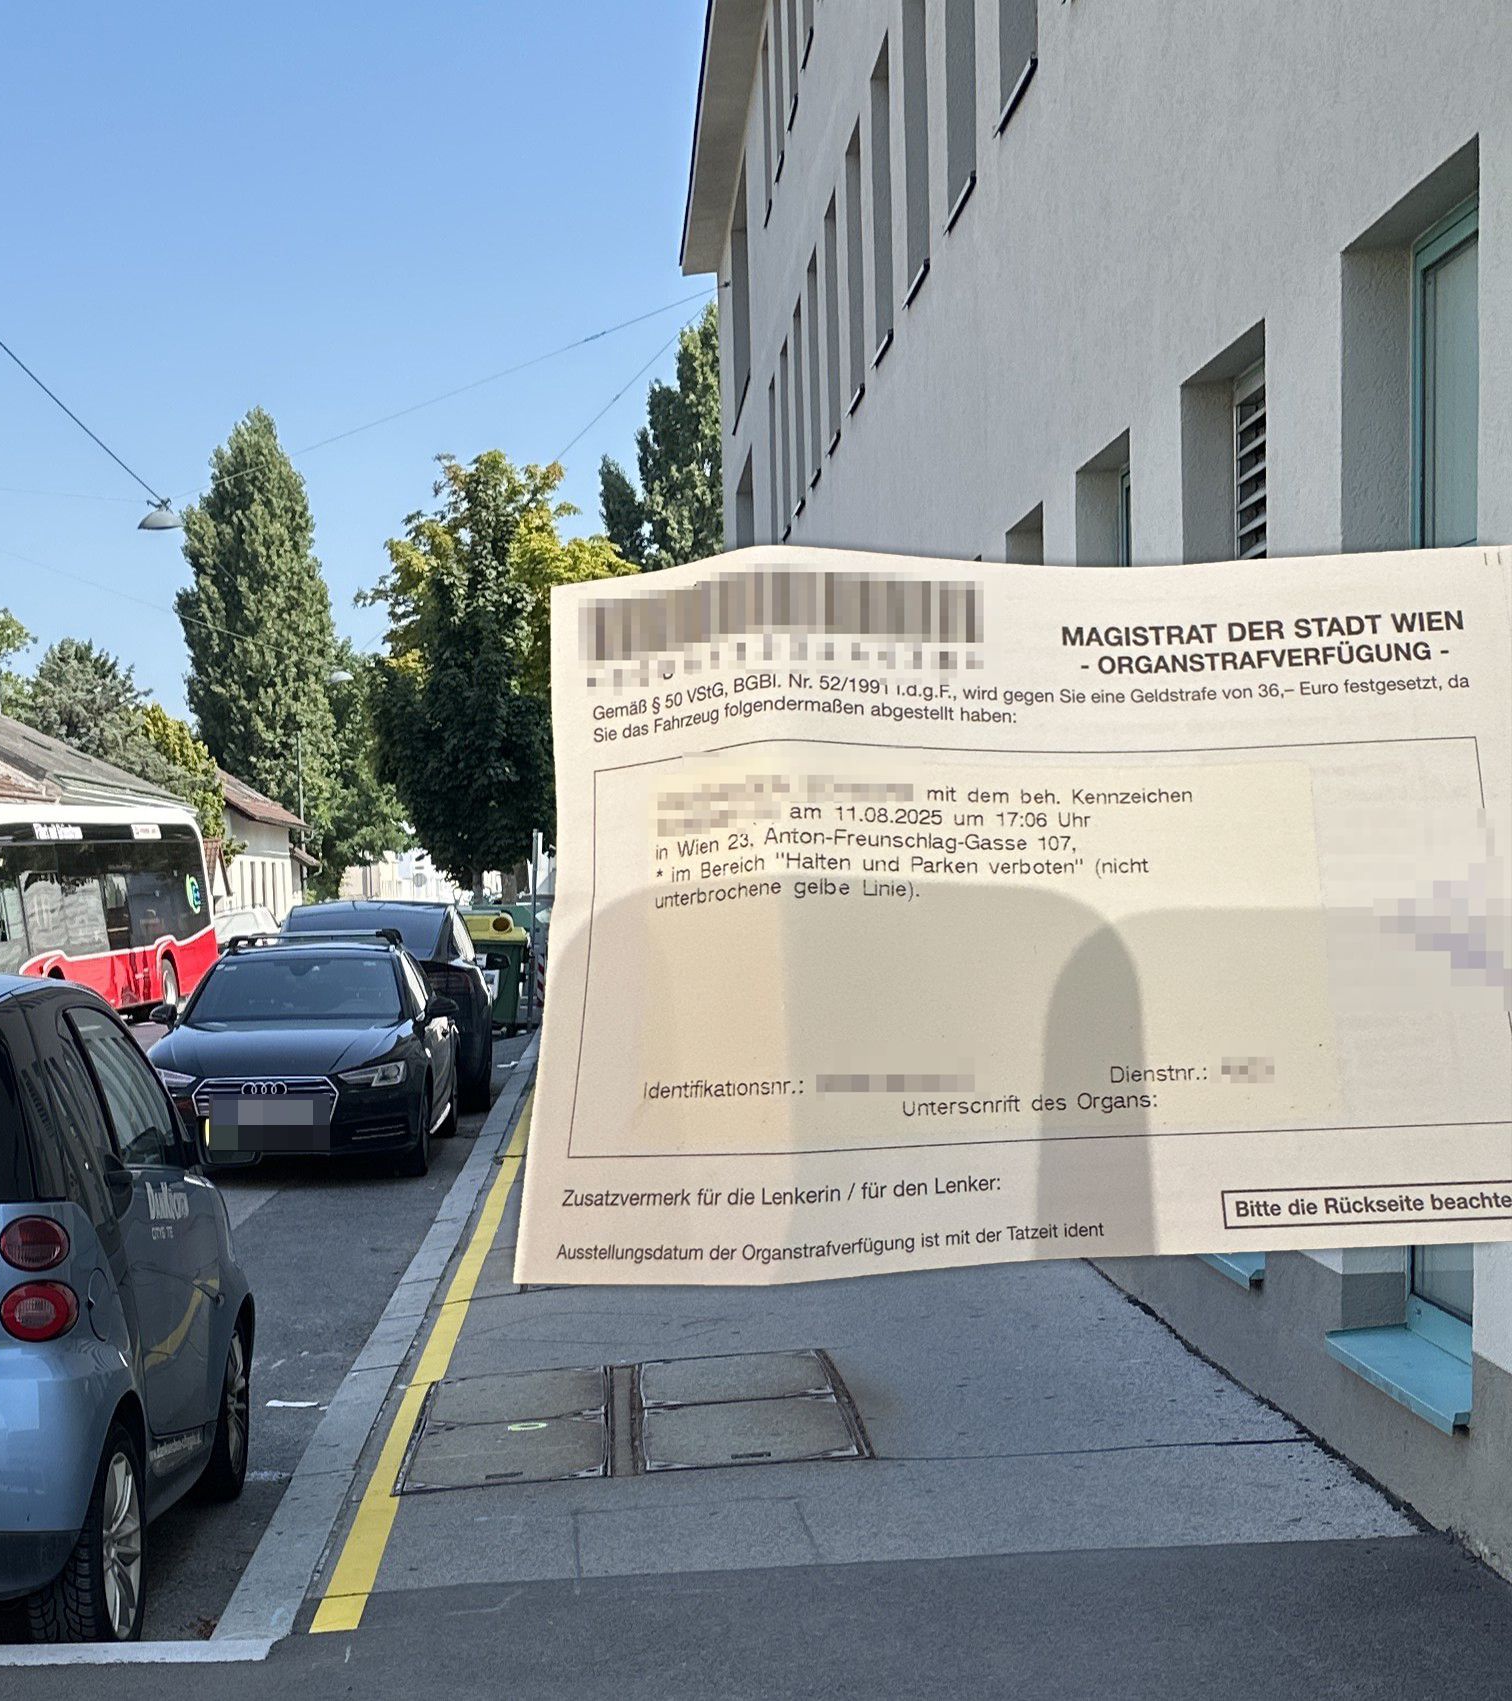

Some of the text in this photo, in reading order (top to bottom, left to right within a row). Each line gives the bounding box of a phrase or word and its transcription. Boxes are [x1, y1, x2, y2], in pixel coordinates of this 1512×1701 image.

[1061, 610, 1464, 647] MAGISTRAT DER STADT WIEN
[1097, 641, 1431, 675] ORGANSTRAFVERFÜGUNG
[593, 699, 647, 721] Gemäß
[651, 696, 661, 715] §
[665, 691, 683, 709] 50
[687, 682, 728, 704] VStG,
[789, 673, 813, 689] Nr.
[962, 685, 997, 701] wird
[1003, 690, 1054, 706] gegen
[1059, 687, 1085, 704] Sie
[1091, 687, 1125, 703] eine
[1130, 686, 1217, 703] Geldstrafe
[1222, 687, 1252, 700] von
[1300, 681, 1338, 696] Euro
[1344, 675, 1442, 696] festgesetzt,
[1447, 674, 1470, 689] da
[593, 695, 1017, 743] Sie das Fahrzeug folgendermaßen abgestellt haben:
[927, 786, 956, 803] mit
[967, 788, 1009, 804] dem
[1021, 789, 1061, 805] beh.
[1072, 787, 1193, 805] Kennzeichen
[790, 806, 821, 819] am
[835, 806, 943, 825] 11.08.2025
[953, 814, 984, 827] um
[998, 812, 1048, 828] 17:06
[1058, 812, 1091, 828] Uhr
[656, 845, 668, 861] in
[677, 838, 719, 857] Wien
[764, 827, 1028, 853] Anton-Freunschlag-Gasse
[1038, 836, 1077, 853] 107,
[671, 852, 1150, 883] im Bereich "Halten und Parken verboten" (nicht
[655, 879, 920, 909] unterbrochene gelbe Linie).
[643, 1079, 804, 1100] Identifikationsnr.:
[1110, 1065, 1207, 1084] Dienstnr.:
[1031, 1095, 1067, 1113] des
[1077, 1092, 1158, 1115] Organs:
[561, 1175, 1001, 1207] Zusatzvermerk für die Lenkerin / für den Lenker:
[1235, 1200, 1281, 1218] Bitte
[1287, 1198, 1318, 1216] die
[1324, 1194, 1425, 1214] Rückseite
[556, 1222, 1104, 1264] Ausstellungsdatum der Organstrafverfügung ist mit der Tatzeit ident
